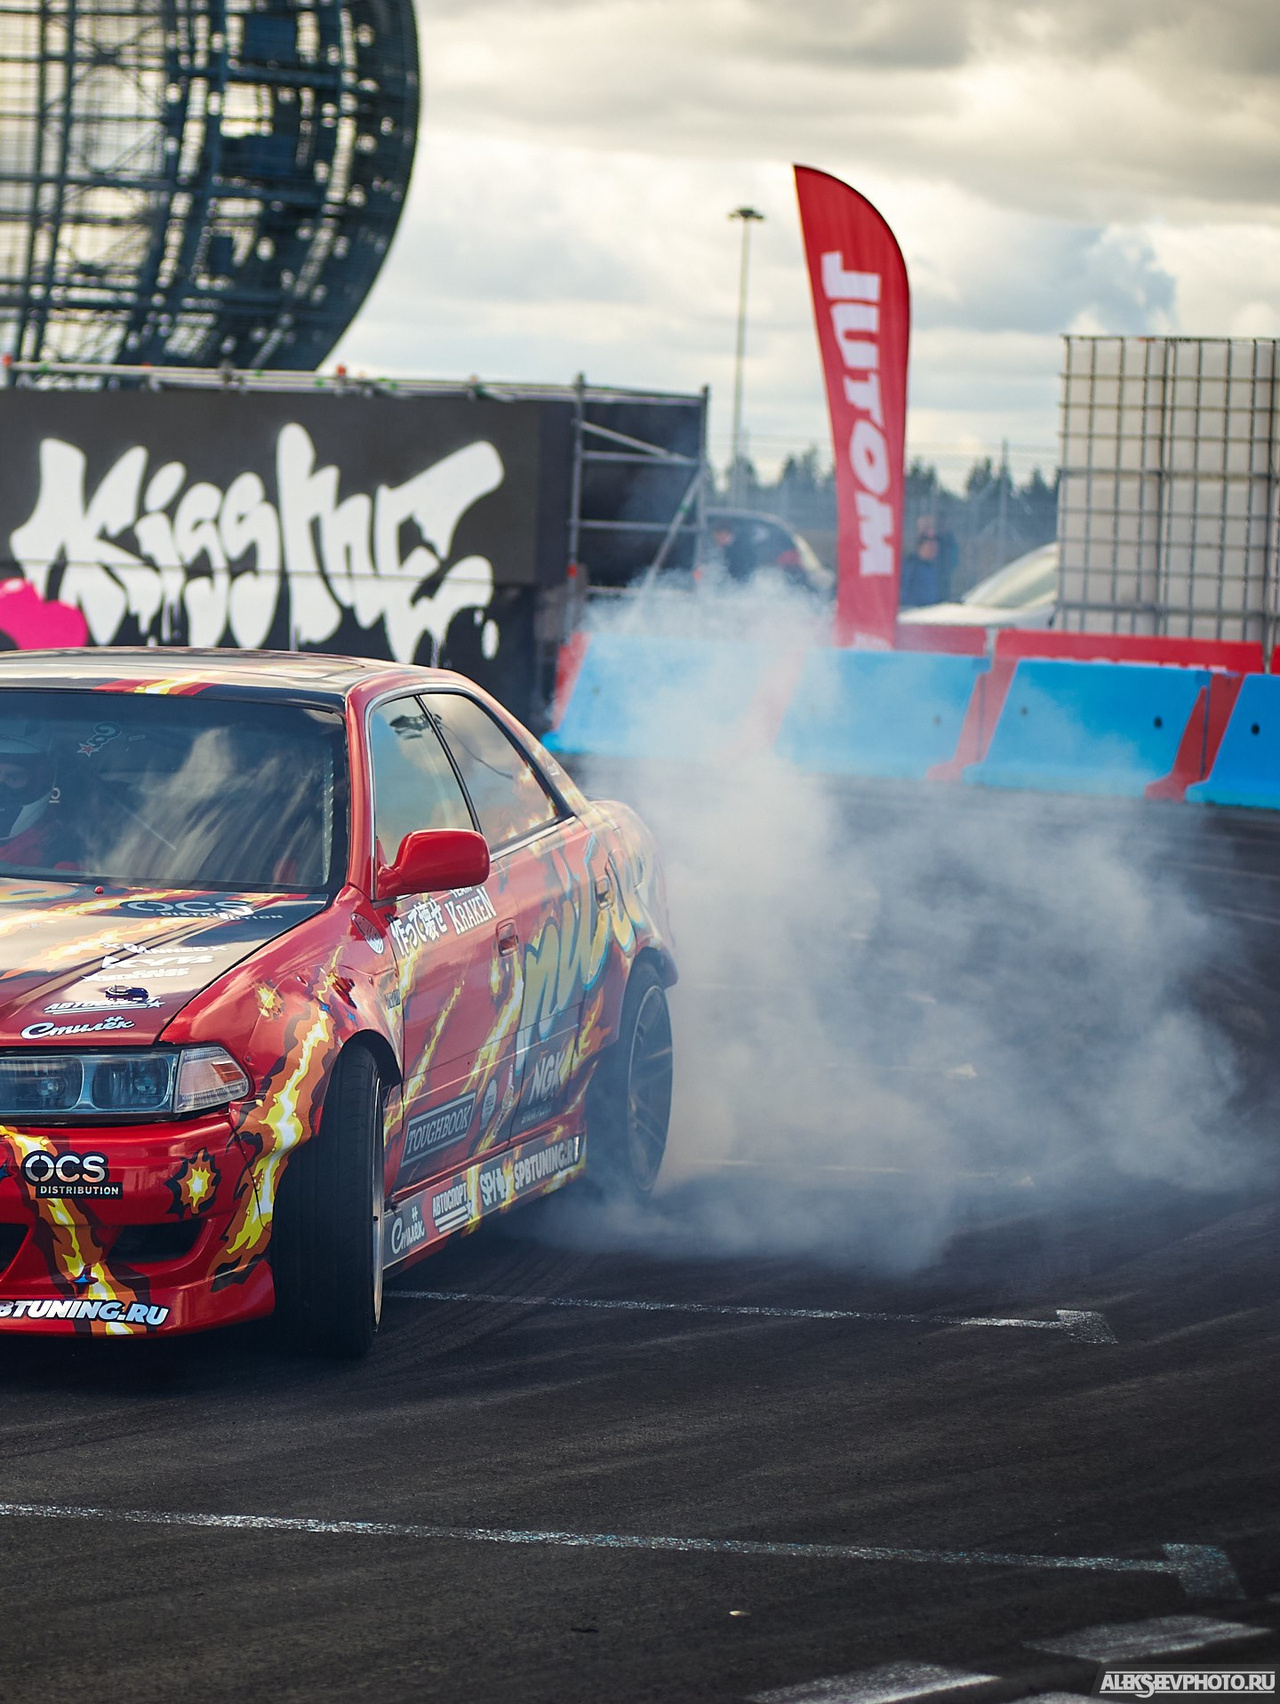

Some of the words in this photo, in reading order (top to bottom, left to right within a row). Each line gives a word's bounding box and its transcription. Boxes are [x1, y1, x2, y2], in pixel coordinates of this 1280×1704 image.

[127, 901, 254, 916] OCS
[445, 886, 496, 934] KRAKEN
[528, 1051, 566, 1105] NGK
[407, 1104, 472, 1155] TOUGHBOOK
[24, 1154, 106, 1183] OCS
[39, 1185, 119, 1196] DISTRIBUTION
